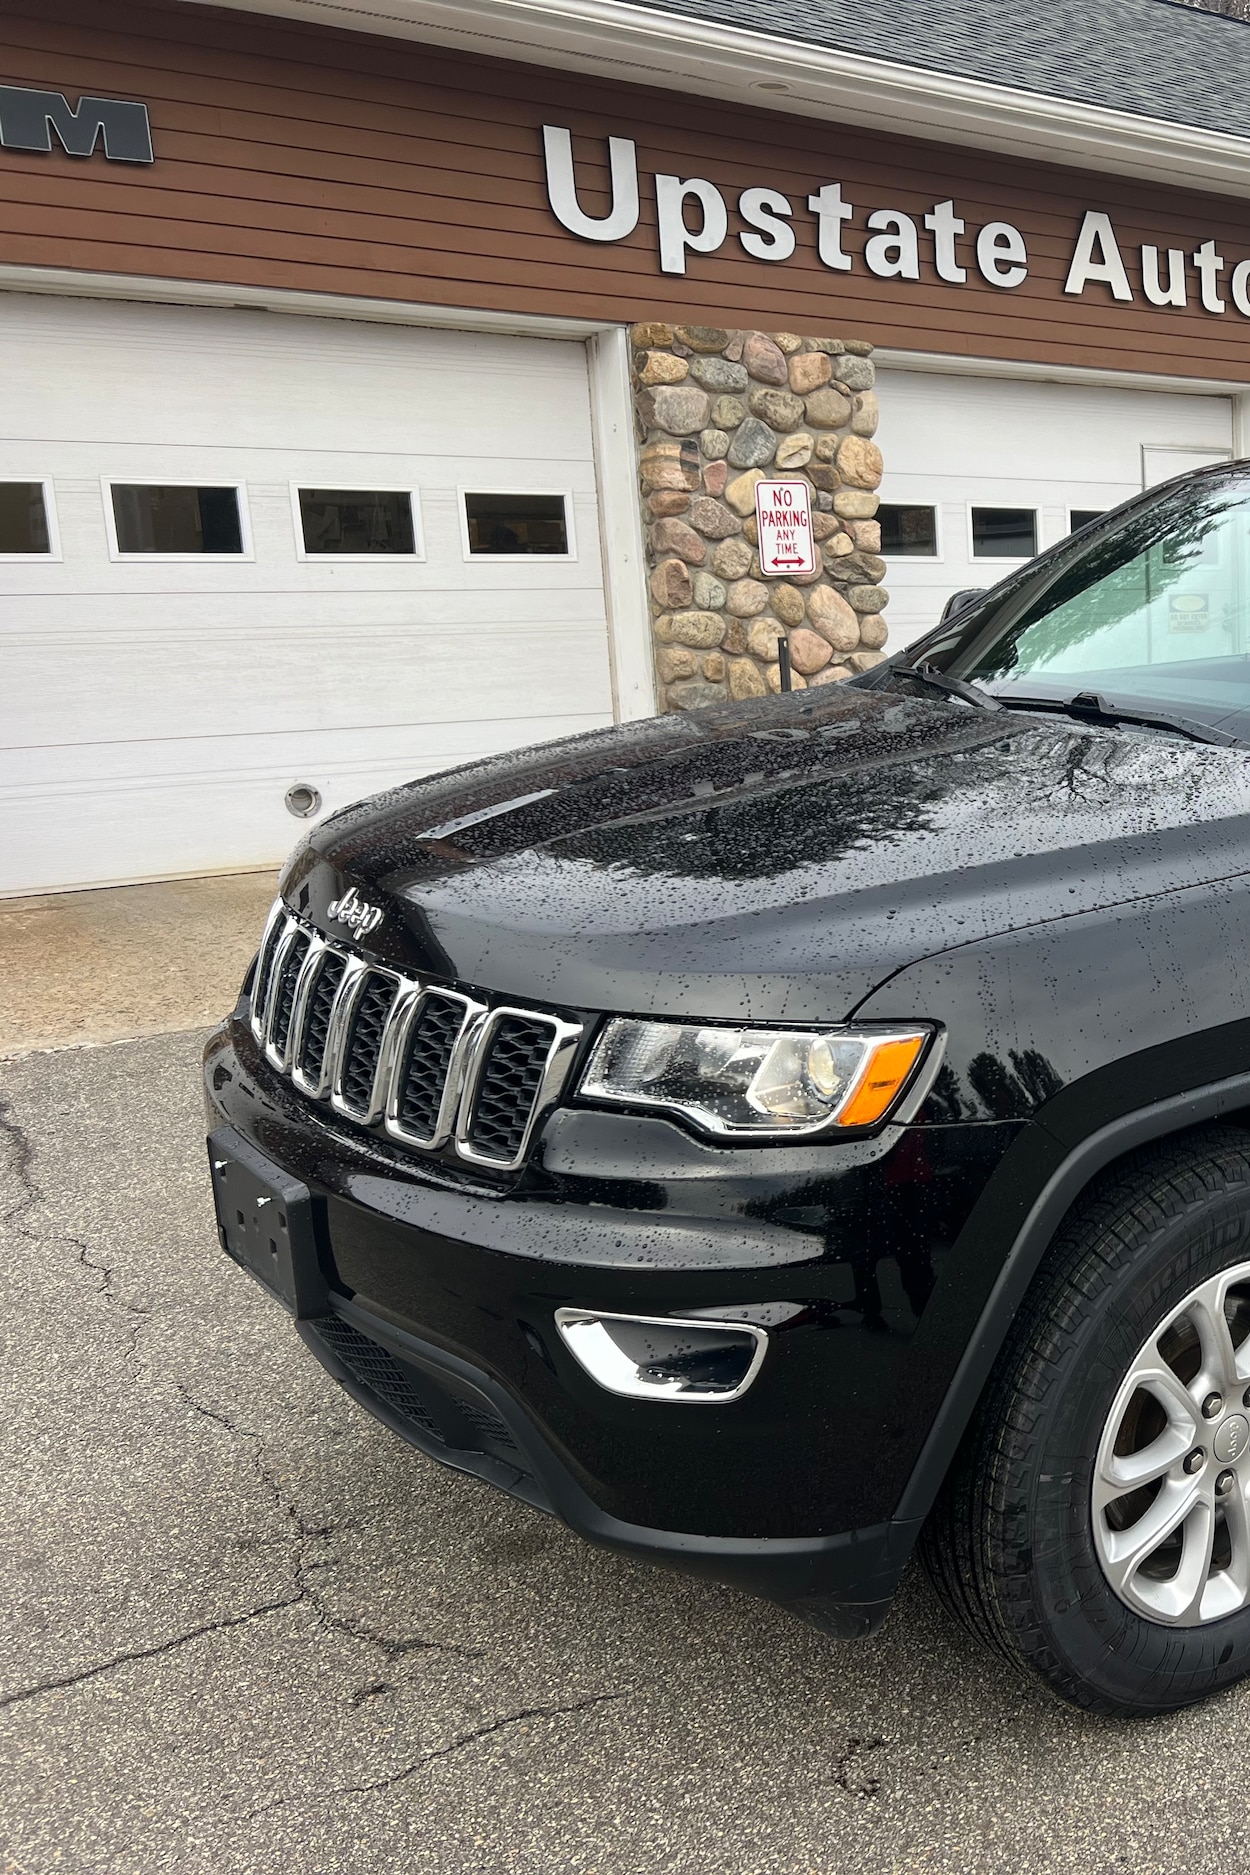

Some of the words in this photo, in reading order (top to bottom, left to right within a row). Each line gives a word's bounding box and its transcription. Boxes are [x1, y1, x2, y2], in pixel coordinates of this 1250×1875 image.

[541, 124, 1029, 288] Upstate
[773, 489, 793, 507] NO
[761, 510, 807, 527] PARKING
[776, 529, 796, 541] ANY
[775, 543, 799, 554] TIME
[326, 886, 384, 941] Jeep
